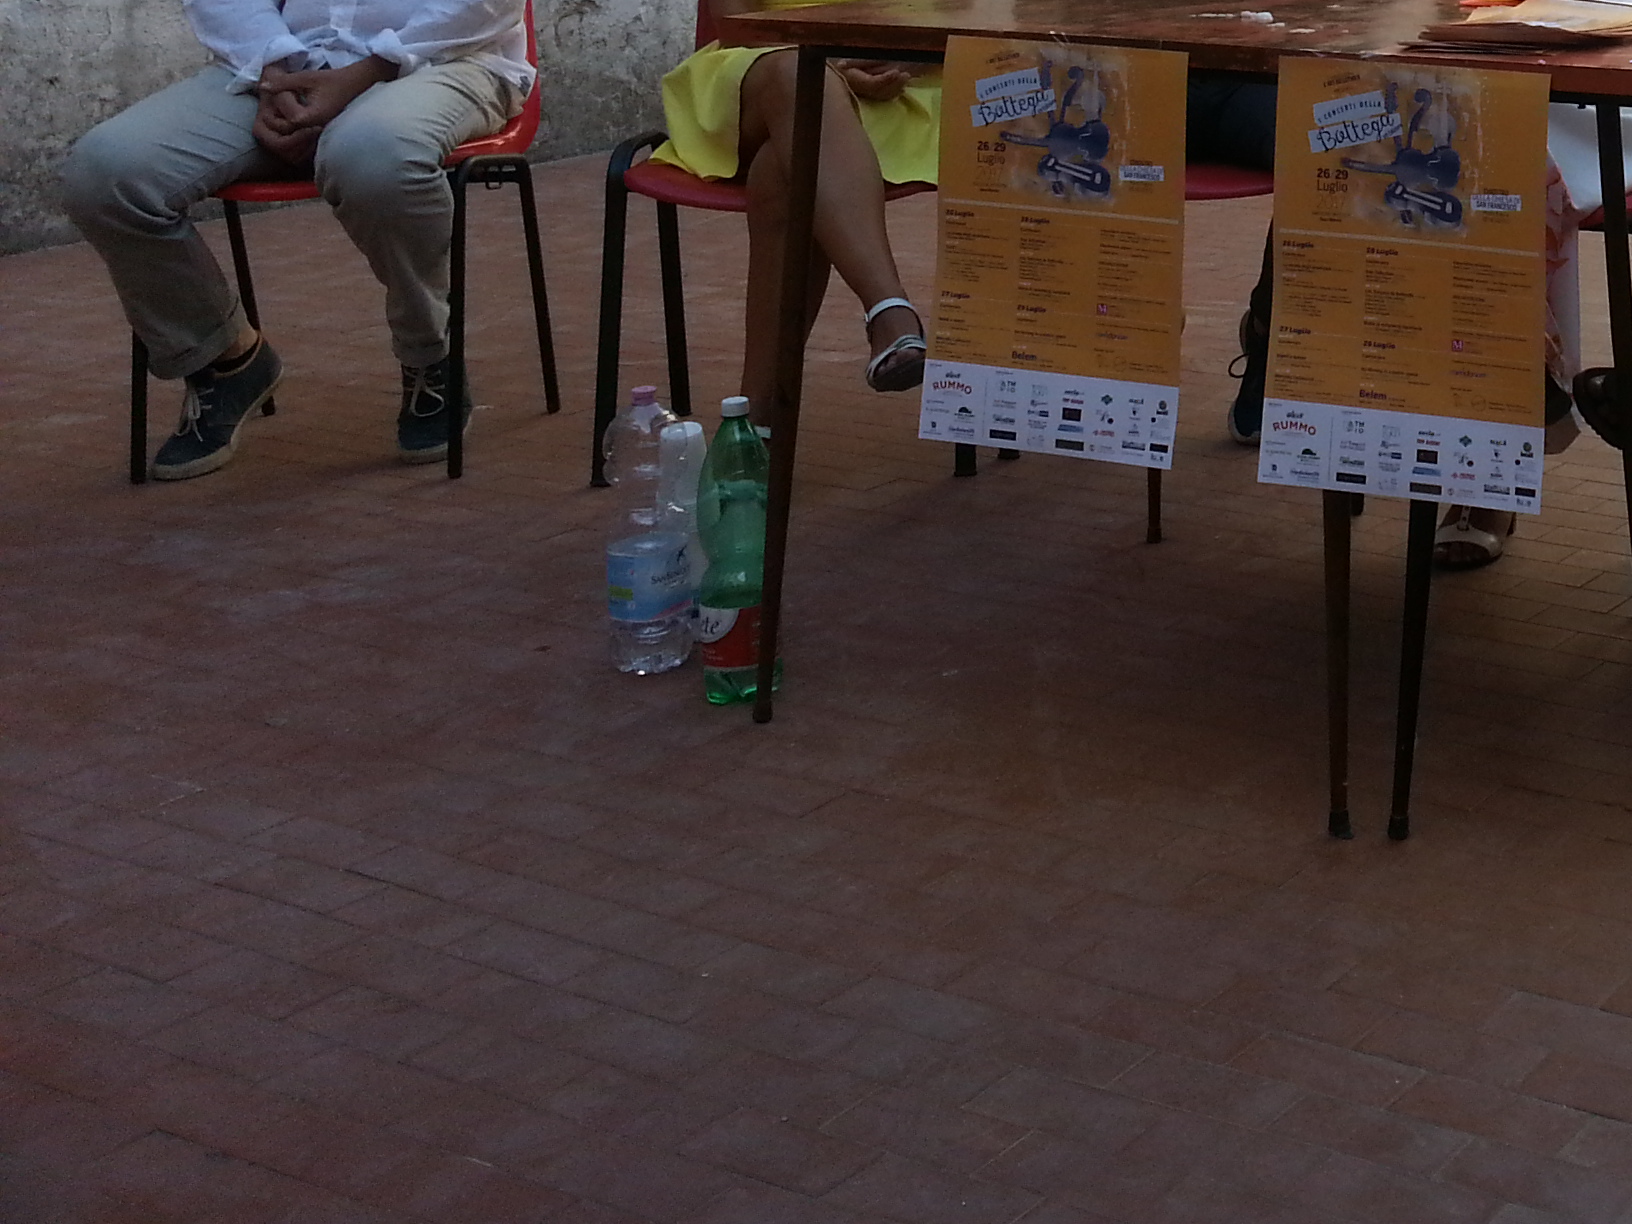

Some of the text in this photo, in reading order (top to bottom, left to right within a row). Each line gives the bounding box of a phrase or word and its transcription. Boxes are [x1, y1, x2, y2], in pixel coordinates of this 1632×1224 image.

[1017, 76, 1038, 87] DELLA
[978, 90, 1050, 126] Bottega
[1359, 100, 1382, 109] DELLA
[1316, 115, 1395, 152] Bottega
[977, 140, 1007, 153] 26 29
[976, 152, 1006, 166] Luglio
[1316, 167, 1349, 180] 26 29
[1316, 179, 1348, 194] Luglio
[1012, 351, 1037, 362] Belem
[932, 380, 972, 395] RUMMO
[1359, 389, 1387, 401] Belem
[1272, 420, 1317, 436] RUMMO
